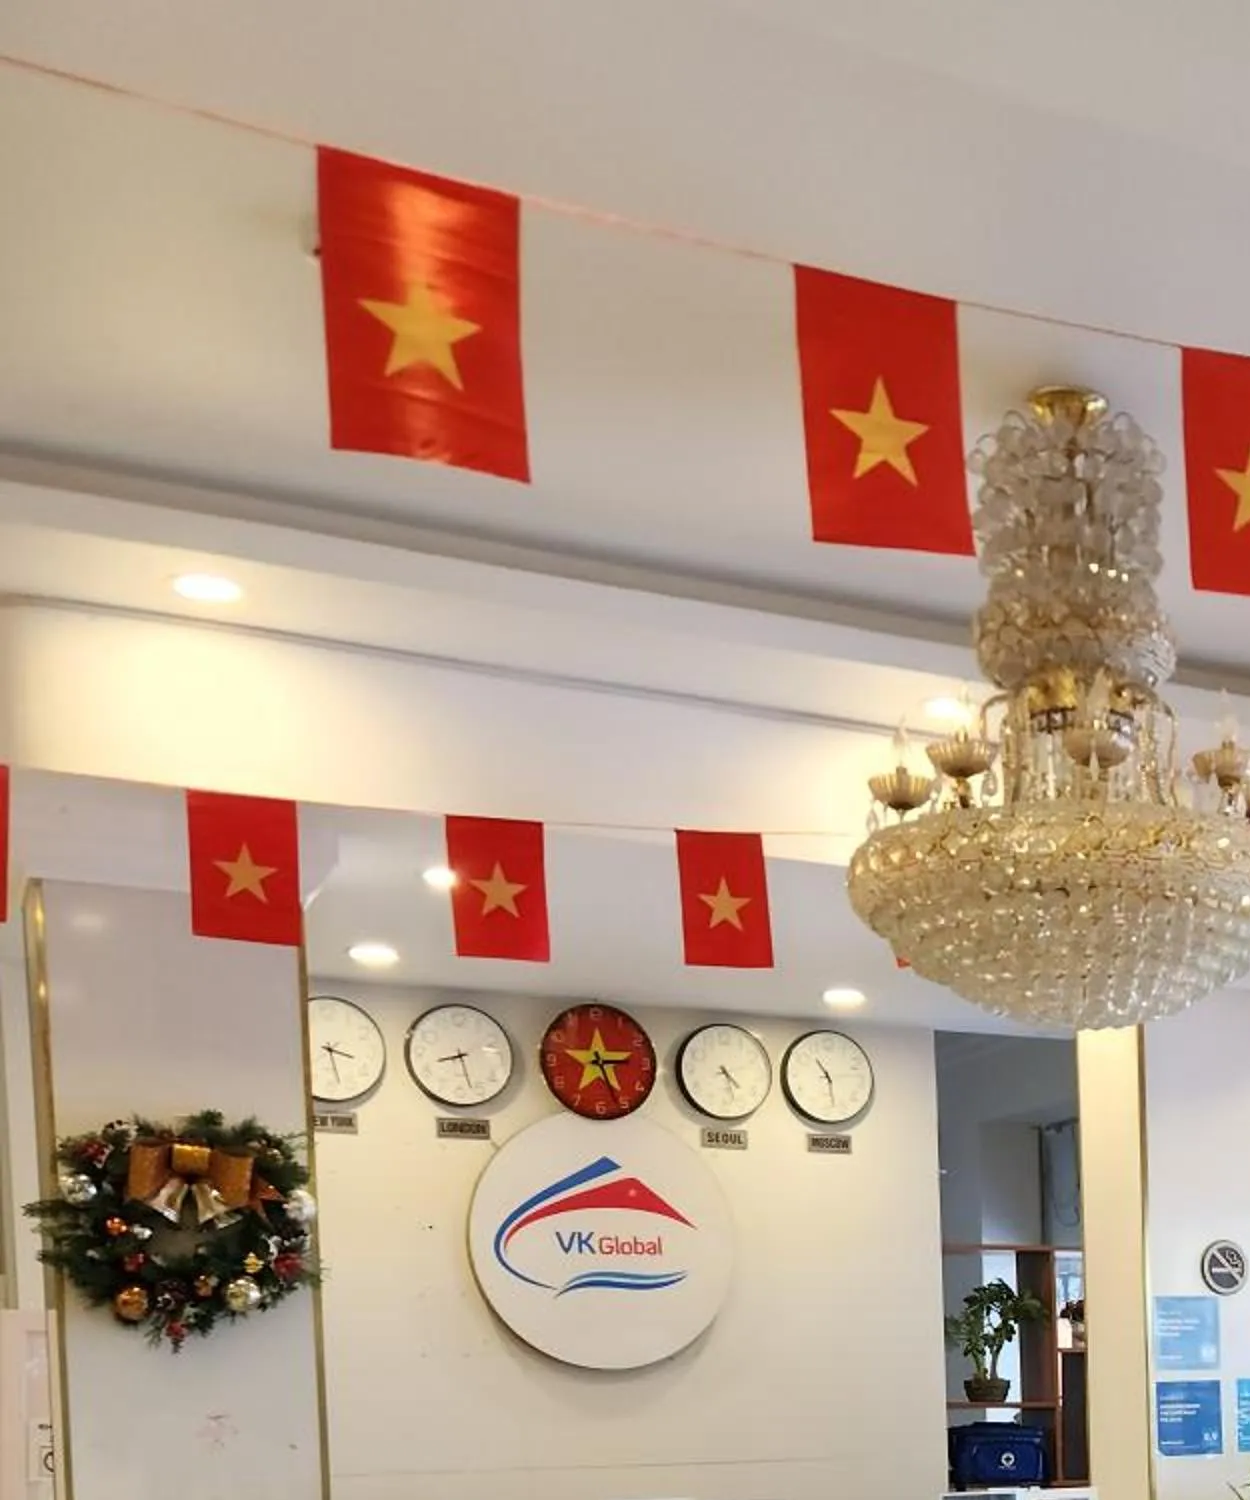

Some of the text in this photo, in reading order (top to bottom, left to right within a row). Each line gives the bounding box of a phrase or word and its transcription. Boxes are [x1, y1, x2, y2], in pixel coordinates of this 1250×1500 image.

[706, 1131, 744, 1145] SEOUL
[555, 1231, 663, 1255] VK Global
